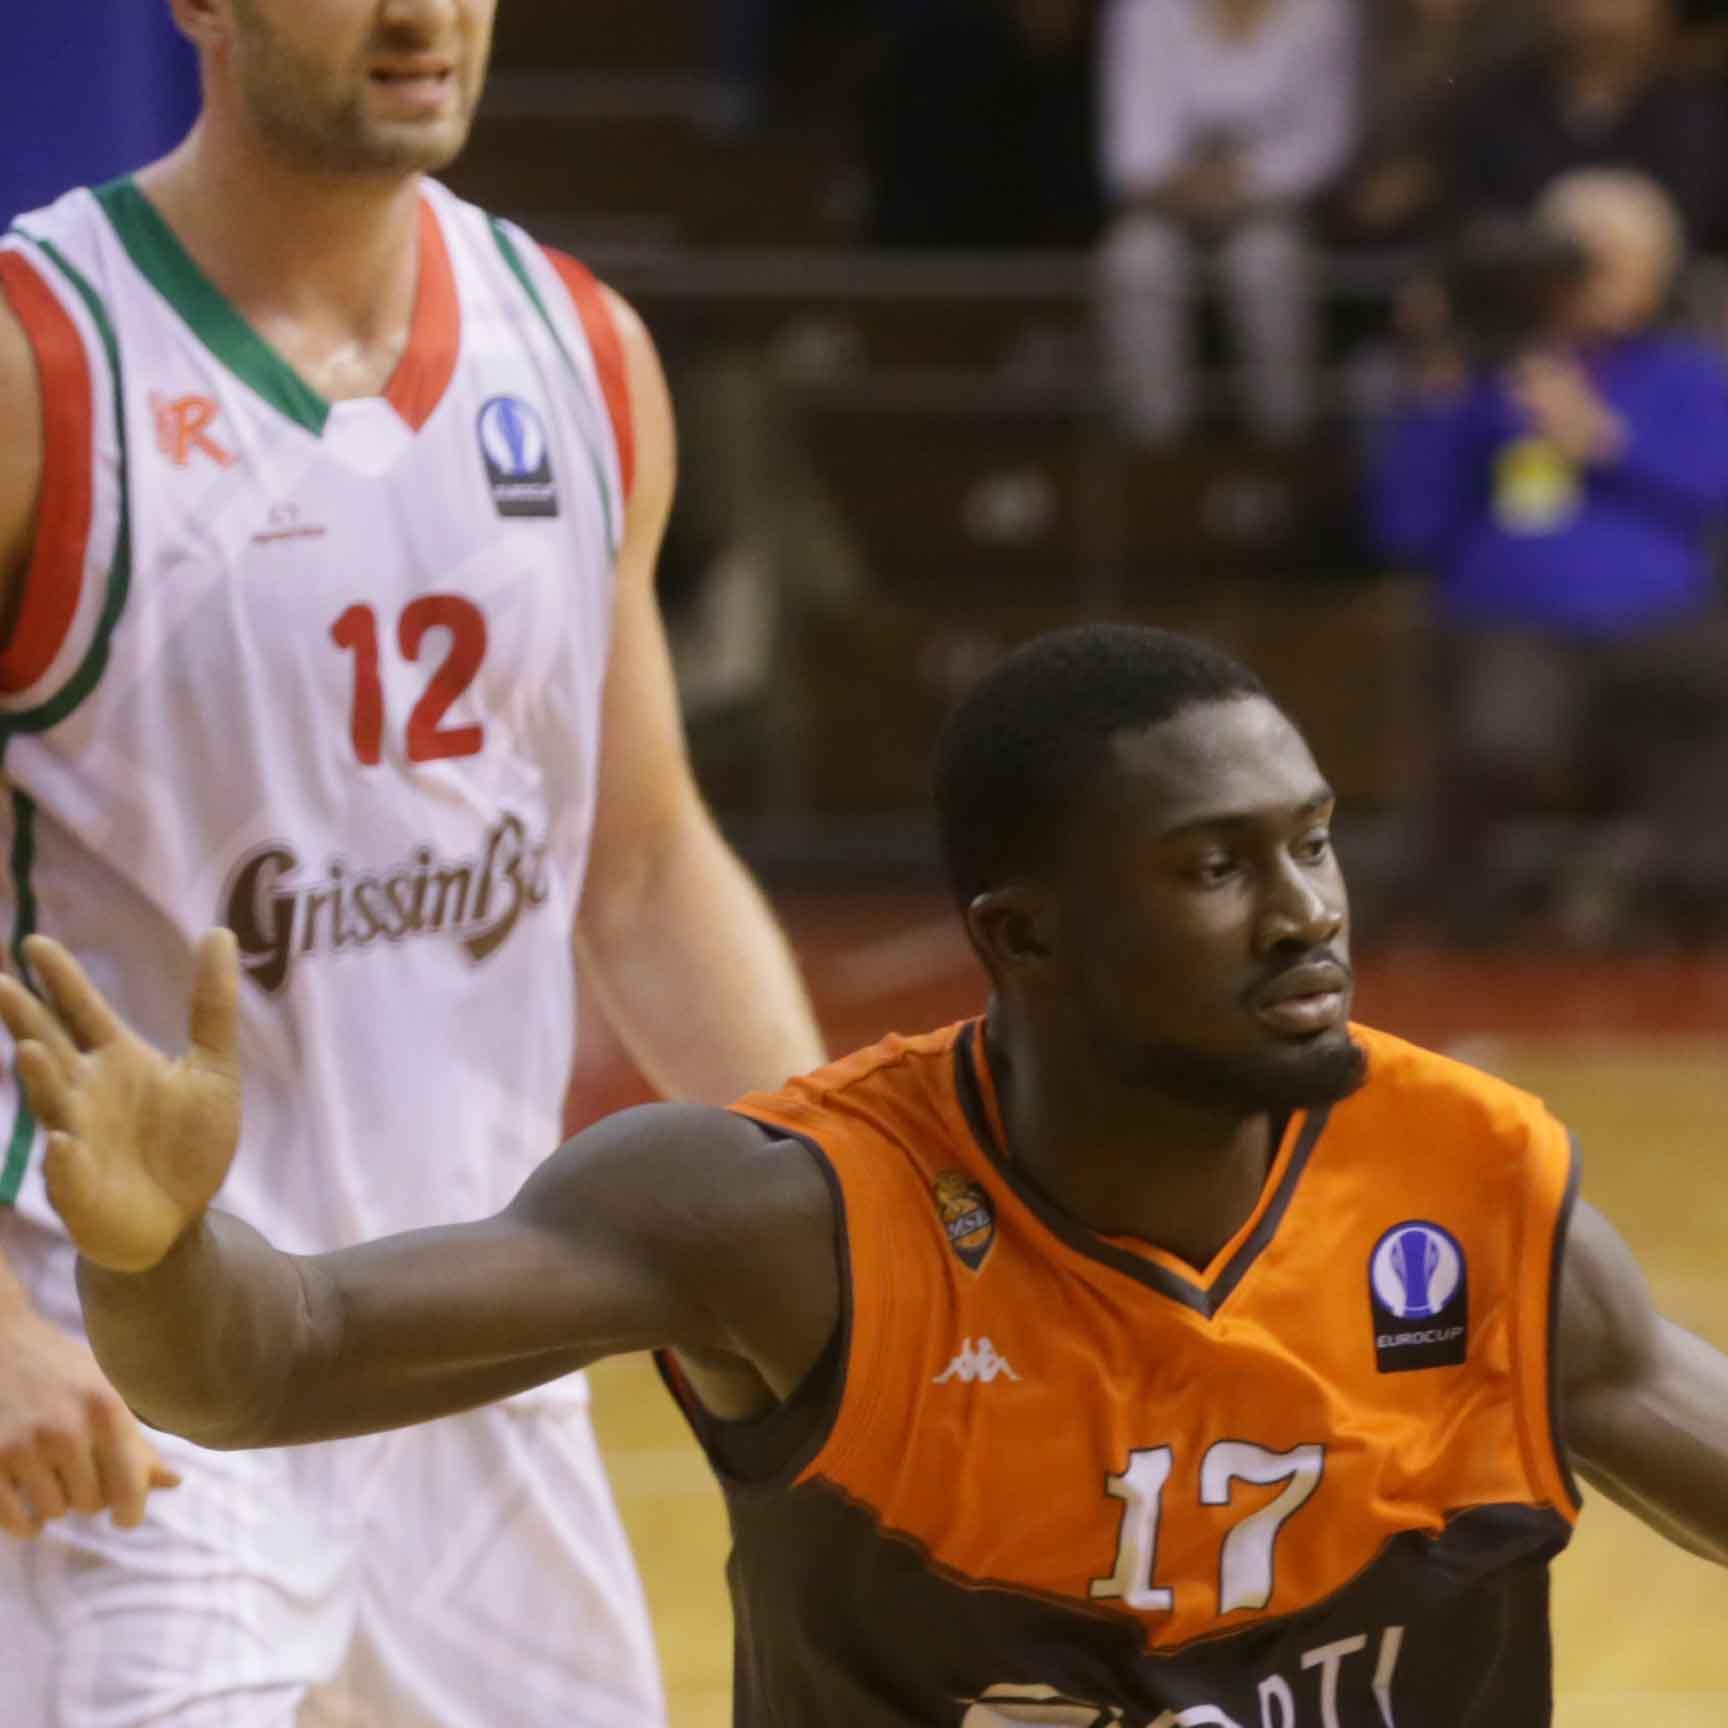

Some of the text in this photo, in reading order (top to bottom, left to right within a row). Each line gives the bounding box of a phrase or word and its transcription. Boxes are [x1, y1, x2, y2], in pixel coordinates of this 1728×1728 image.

[329, 593, 489, 768] 12
[1376, 1326, 1465, 1350] EUROCUP
[1089, 1439, 1326, 1615] 17
